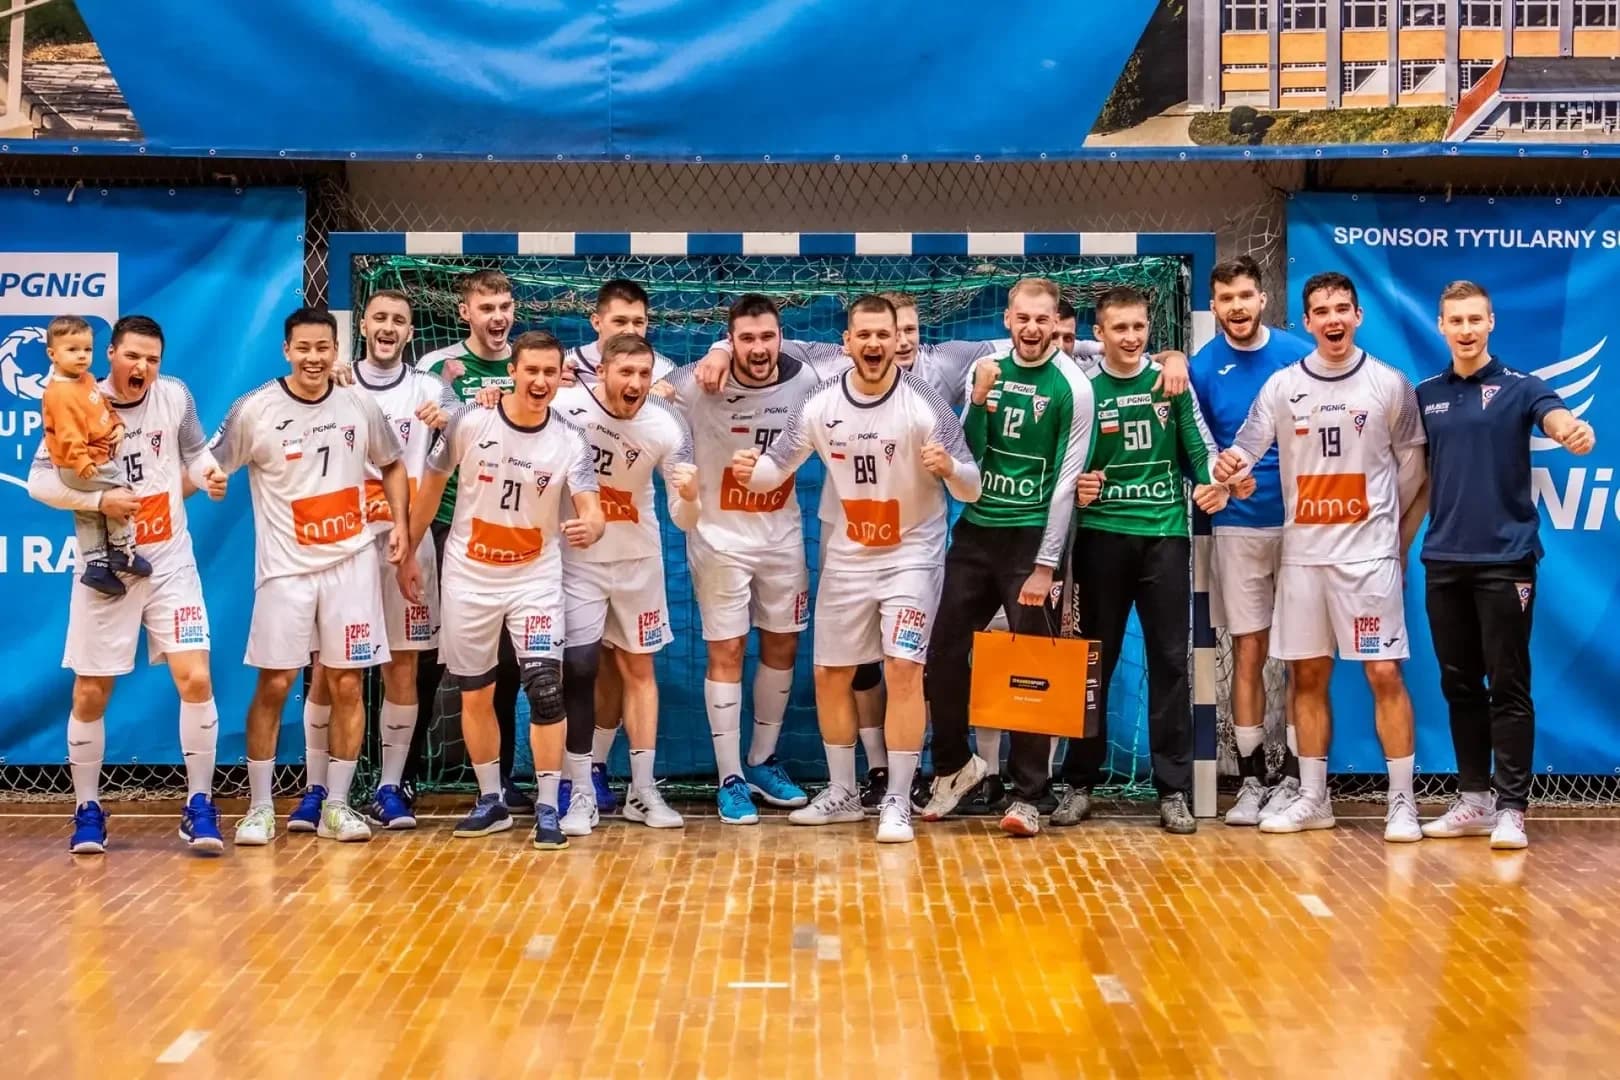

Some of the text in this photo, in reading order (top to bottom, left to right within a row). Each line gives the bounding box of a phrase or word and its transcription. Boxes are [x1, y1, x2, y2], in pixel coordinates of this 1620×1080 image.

[1334, 227, 1449, 247] SPONSOR
[1456, 229, 1596, 248] TYTULARNY
[0, 273, 106, 298] PGNiG
[1002, 406, 1025, 439] 12
[1124, 420, 1152, 451] 50
[1318, 427, 1341, 457] 19
[122, 452, 144, 482] 15
[317, 445, 330, 477] 7
[590, 444, 614, 476] 22
[853, 455, 877, 484] 89
[500, 479, 522, 512] 21
[728, 487, 783, 506] nmc
[981, 471, 1035, 497] nmc
[1107, 481, 1167, 499] nmc
[1300, 498, 1362, 519] nmc
[303, 512, 355, 539] nmc
[180, 606, 202, 622] ZPEC
[410, 604, 430, 620] ZPEC
[529, 615, 552, 629] ZPEC
[902, 608, 926, 629] ZPEC
[1359, 616, 1380, 632] ZPEC
[350, 622, 370, 639] ZPEC
